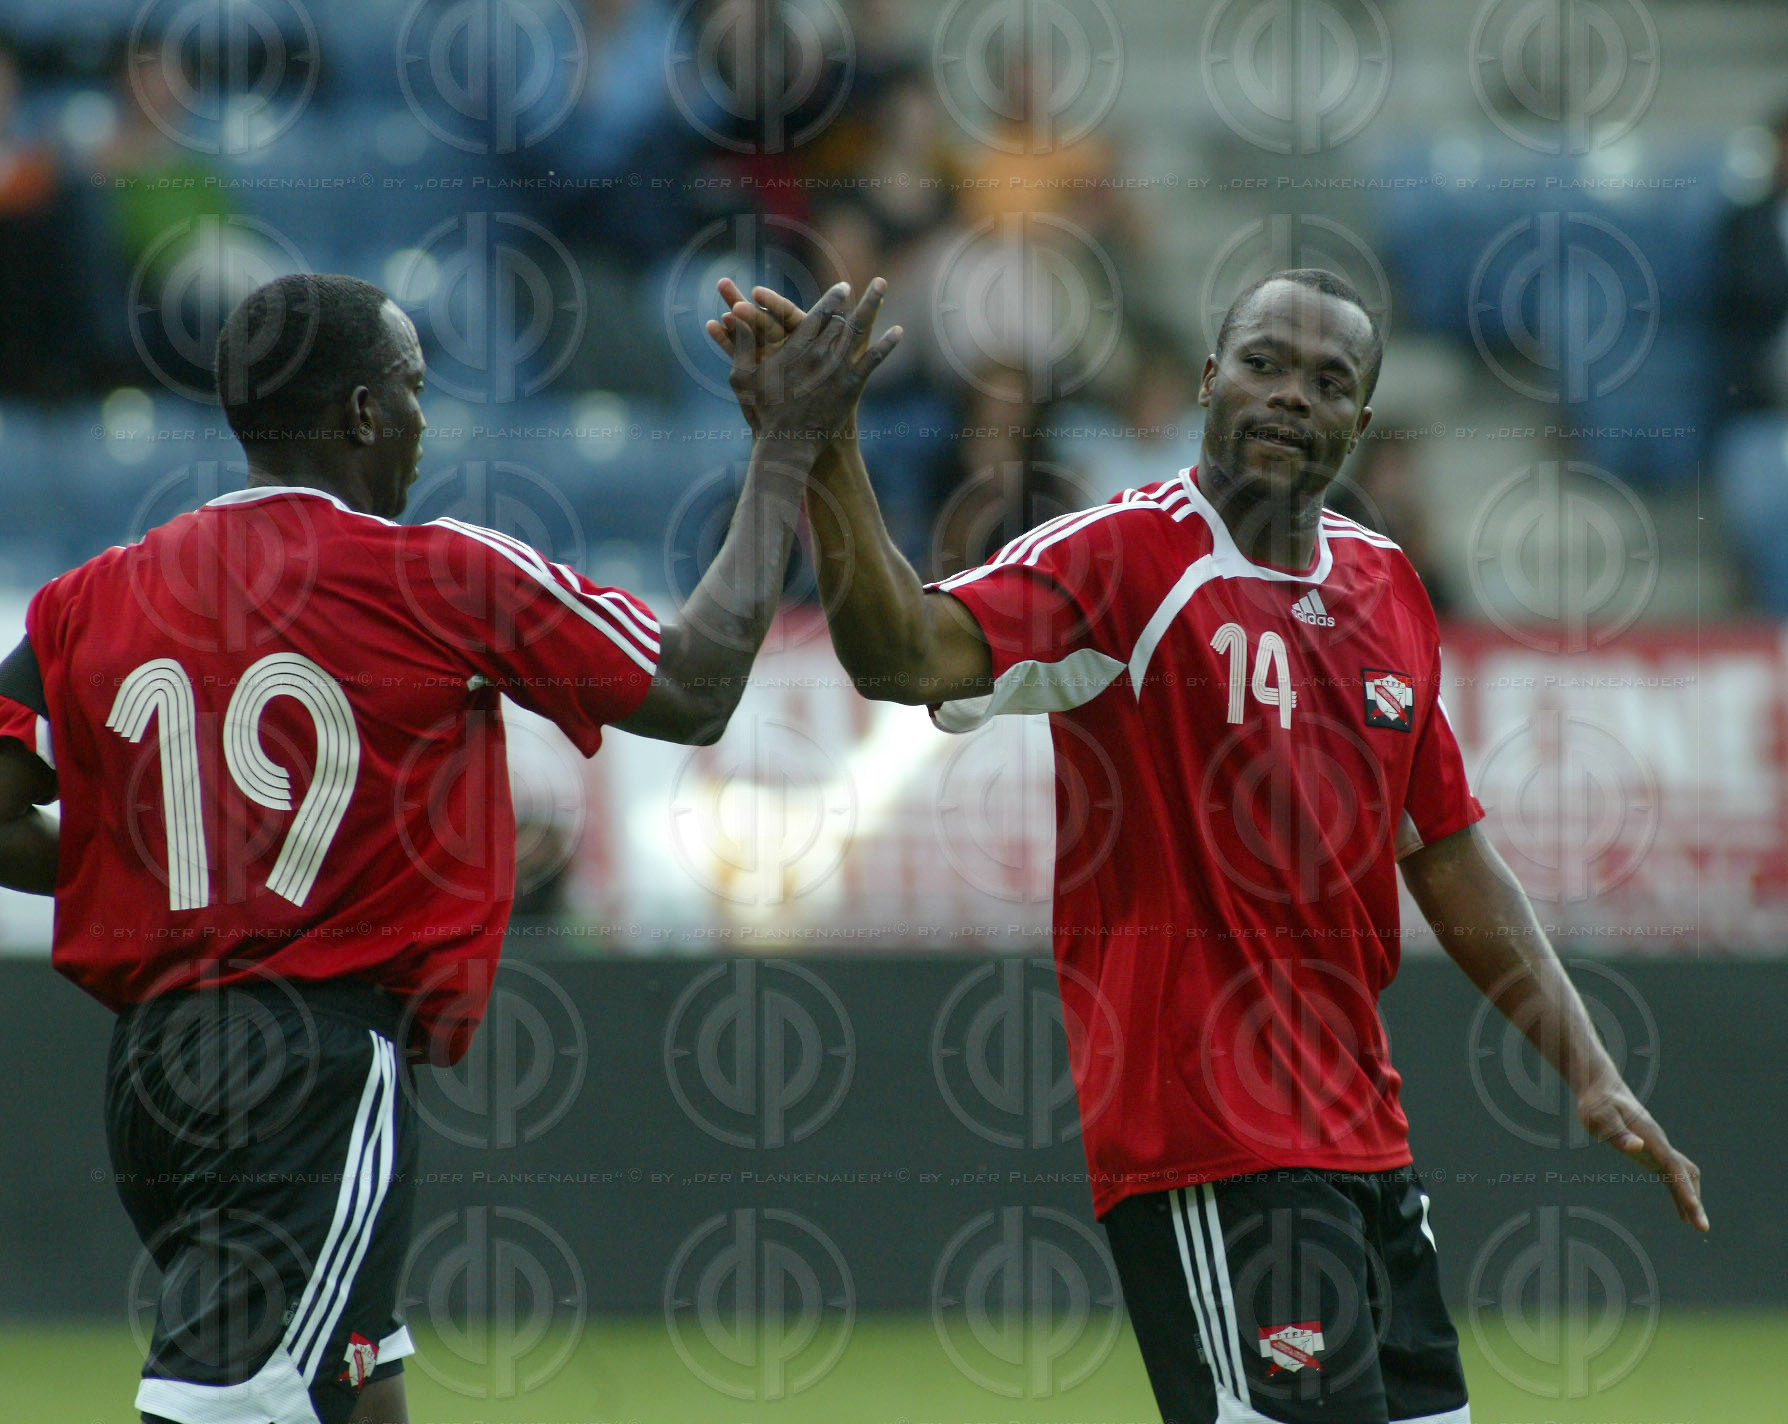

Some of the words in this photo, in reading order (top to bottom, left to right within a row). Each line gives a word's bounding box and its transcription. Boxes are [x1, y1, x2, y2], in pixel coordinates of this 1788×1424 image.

[1291, 609, 1336, 627] adidas
[1210, 622, 1297, 729] 14
[105, 652, 360, 911] 19
